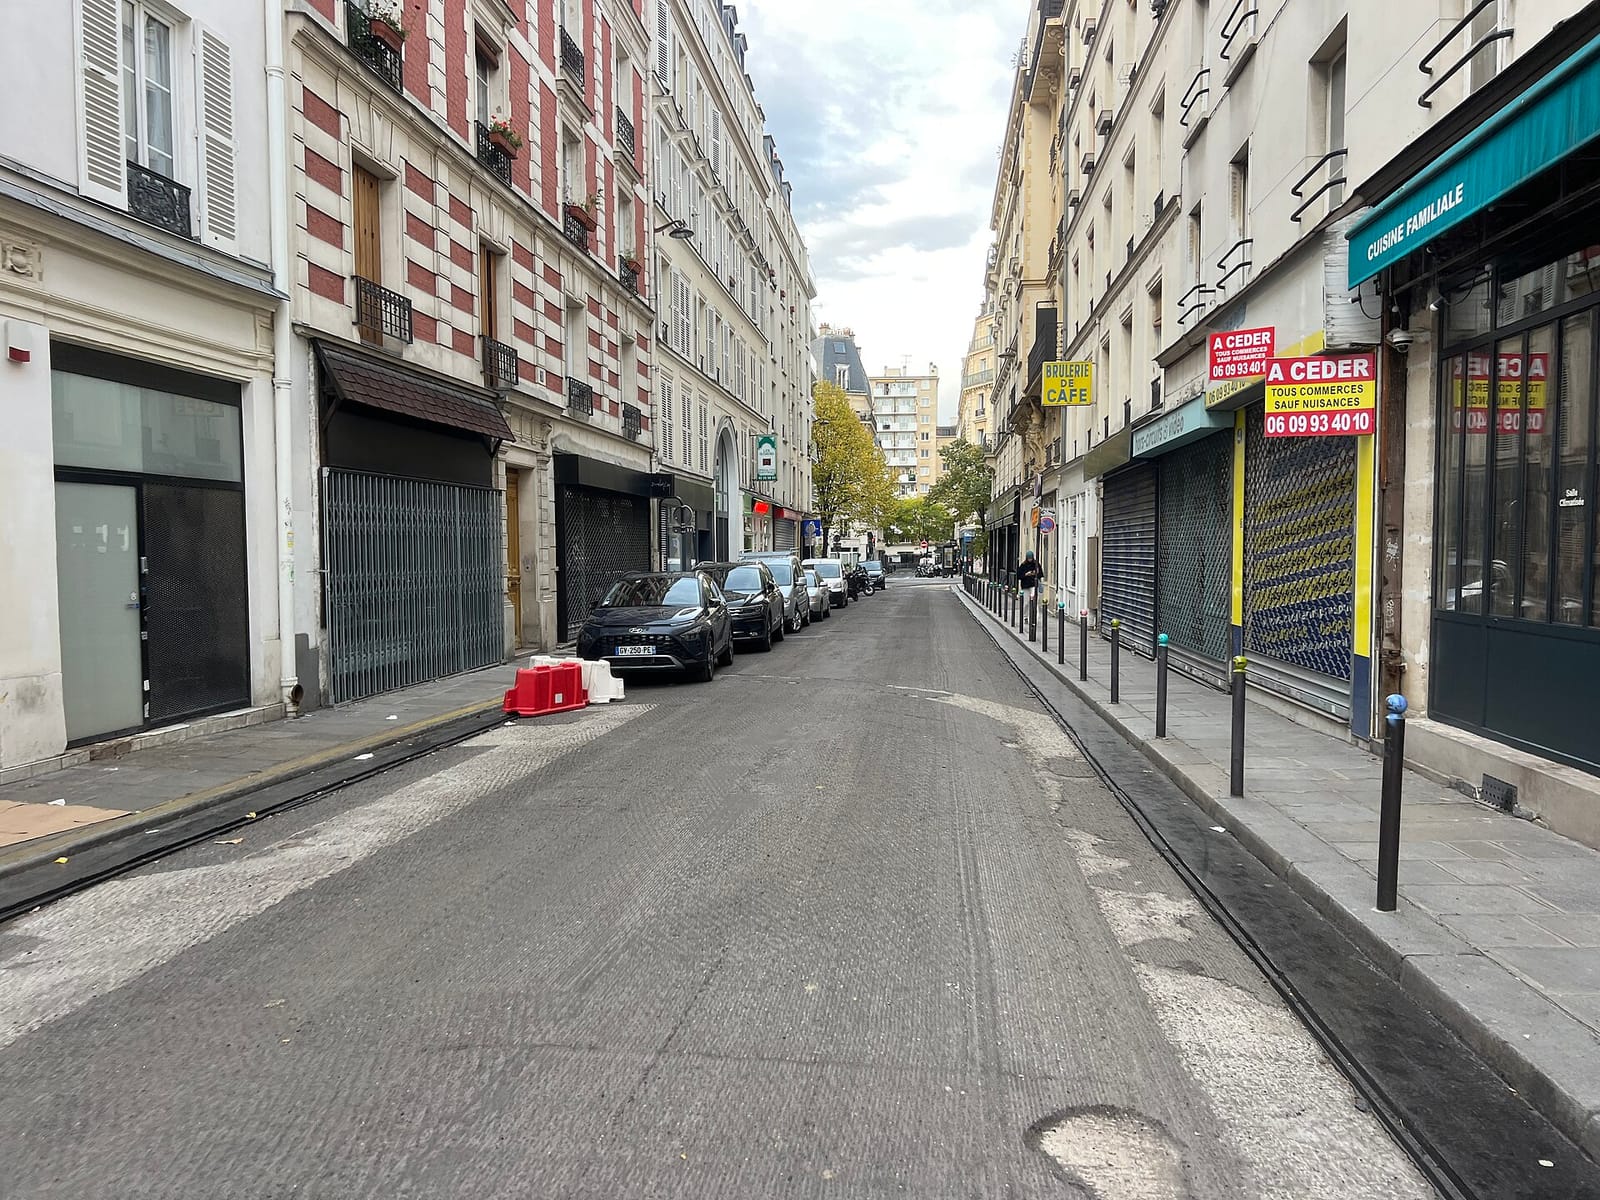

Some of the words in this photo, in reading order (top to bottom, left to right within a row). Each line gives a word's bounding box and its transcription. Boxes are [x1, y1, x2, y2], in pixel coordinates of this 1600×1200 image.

[1367, 223, 1404, 261] CUISINE
[1406, 182, 1464, 237] FAMILIALE
[1213, 337, 1223, 350] A
[1226, 331, 1271, 349] CEDER
[1232, 347, 1268, 355] COMMERCES
[1233, 353, 1266, 361] NUISANCES
[1046, 364, 1089, 377] BRULERIE
[1213, 365, 1224, 377] 06
[1225, 363, 1236, 376] 09
[1237, 362, 1248, 374] 93
[1267, 363, 1284, 381] A
[1290, 358, 1369, 380] CEDER
[1060, 379, 1074, 387] DE
[1047, 388, 1087, 402] CAFE
[1271, 388, 1297, 397] TOUS
[1299, 384, 1364, 396] COMMERCES
[1274, 400, 1300, 410] SAUF
[1303, 397, 1360, 408] NUISANCES
[1267, 416, 1285, 433] 06
[1288, 415, 1307, 432] 09
[1310, 415, 1329, 431] 93
